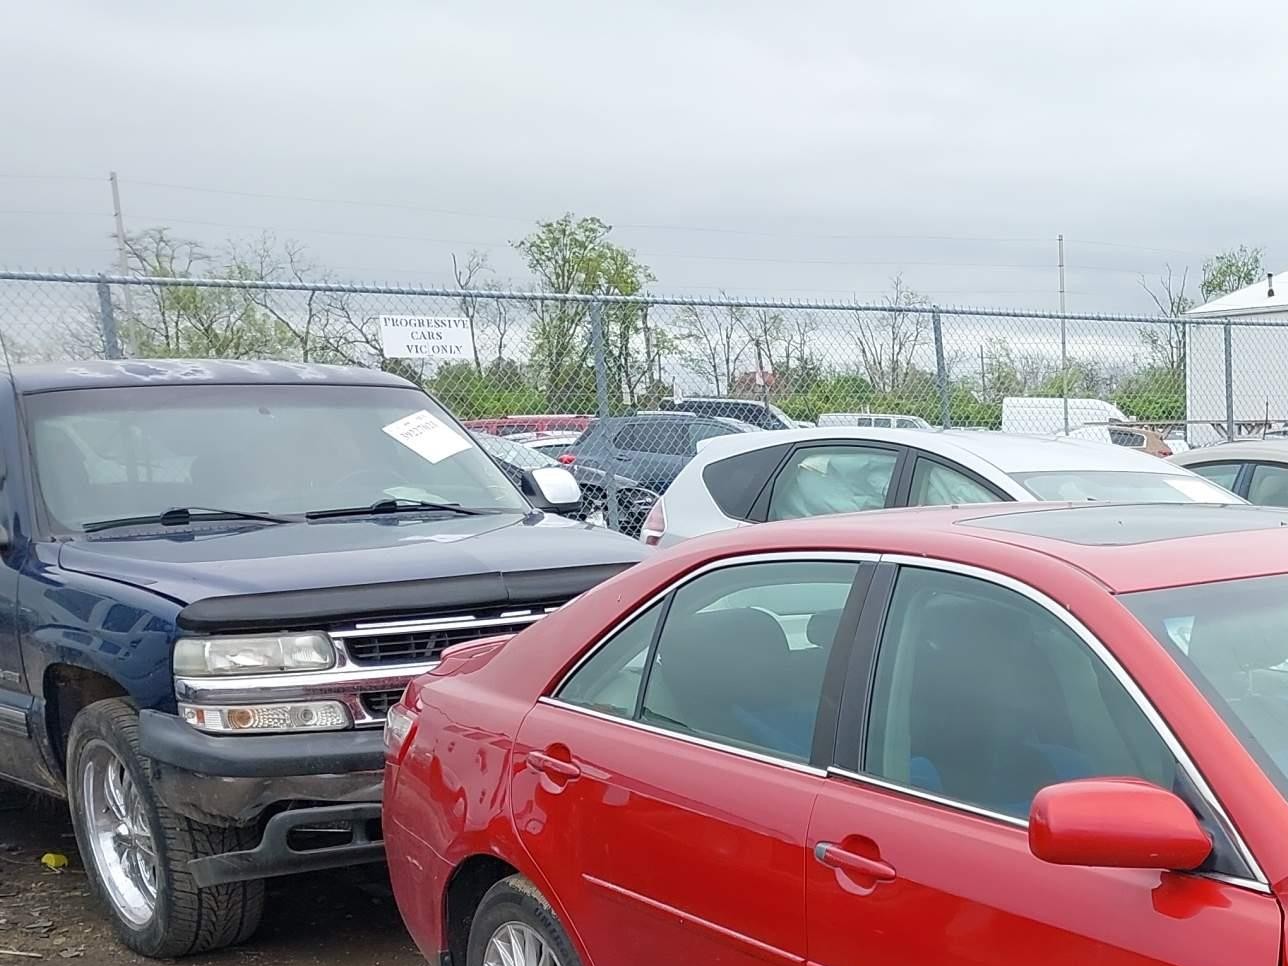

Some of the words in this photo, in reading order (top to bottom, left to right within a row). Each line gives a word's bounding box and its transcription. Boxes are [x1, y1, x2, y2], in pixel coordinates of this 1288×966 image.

[383, 317, 469, 329] PROGRESSIVE
[410, 331, 443, 341] CARS
[406, 344, 427, 354] VIC
[431, 344, 463, 354] ONLY
